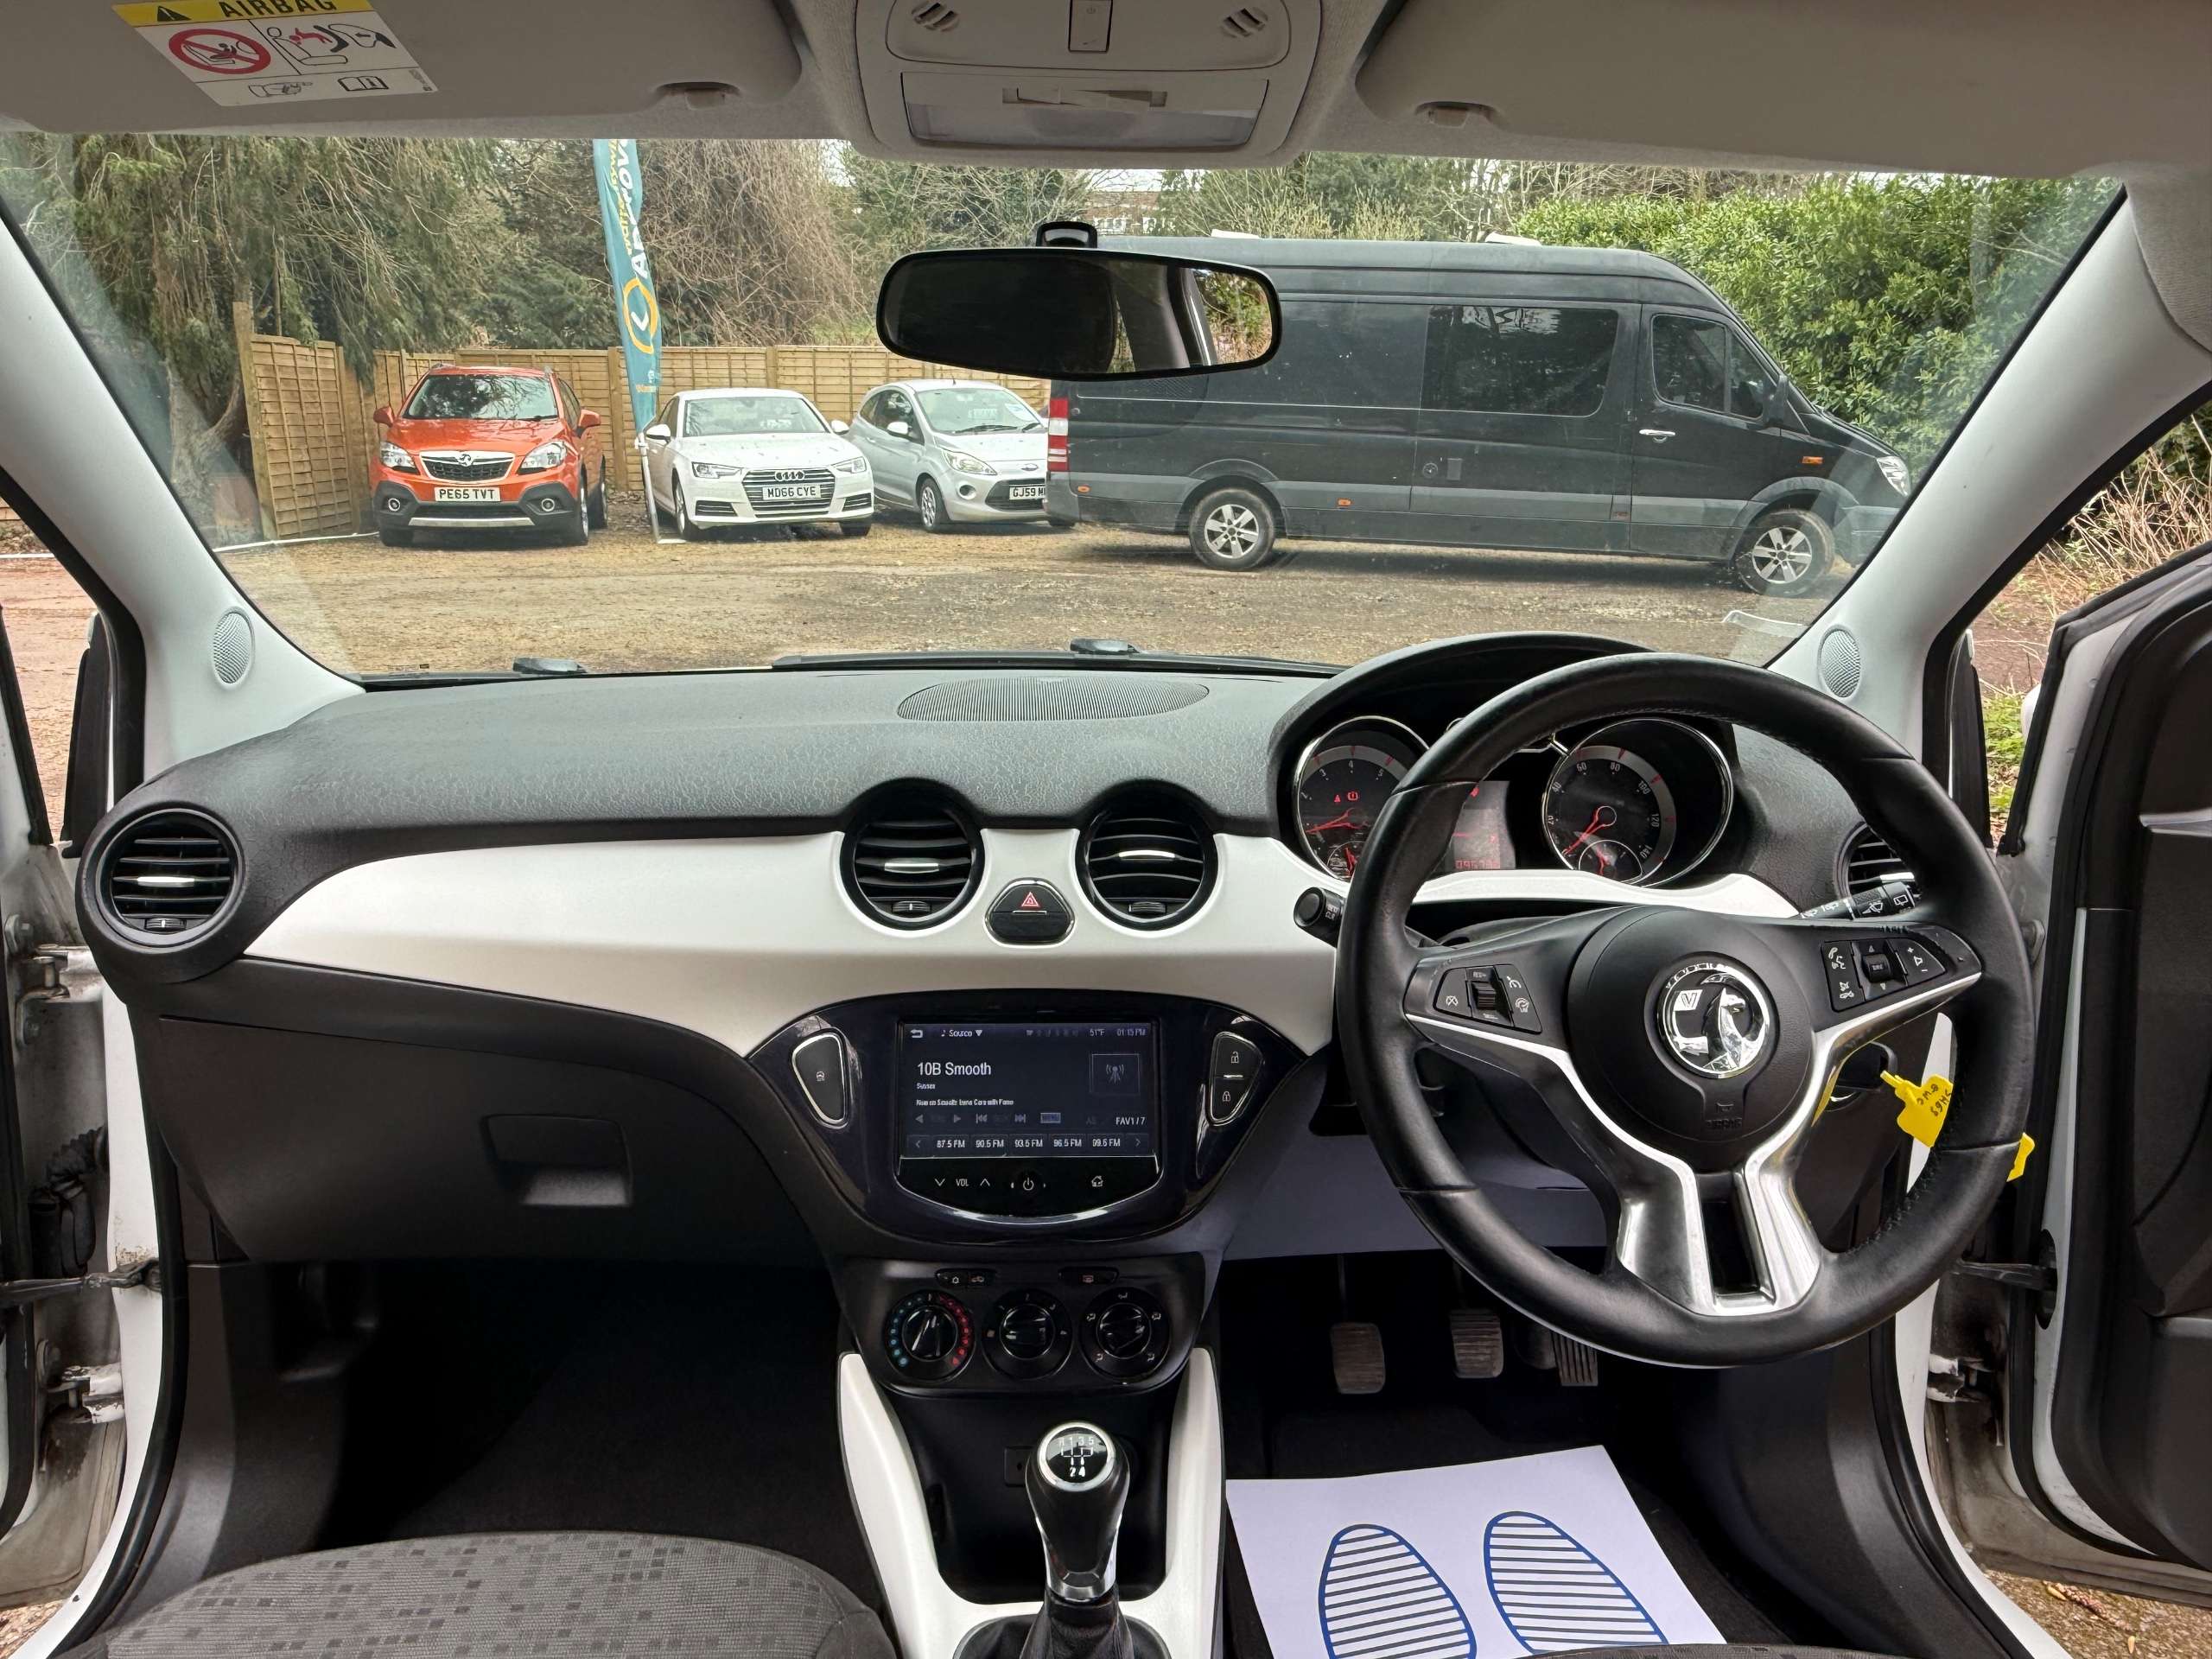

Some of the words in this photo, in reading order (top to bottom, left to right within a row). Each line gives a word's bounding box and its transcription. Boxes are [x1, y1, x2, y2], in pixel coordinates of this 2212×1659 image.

[219, 0, 336, 17] AIRBAG
[439, 488, 469, 499] PE65
[472, 489, 495, 499] TVT
[767, 487, 795, 498] MD66
[797, 486, 817, 496] CYE
[1013, 487, 1035, 498] GJ59
[917, 1062, 942, 1076] 10B
[945, 1062, 992, 1076] Smooth
[954, 1140, 965, 1148] FM
[993, 1140, 1004, 1148] FM
[1032, 1140, 1043, 1148] FM
[1071, 1139, 1082, 1147] FM
[1109, 1138, 1121, 1147] FM
[956, 1178, 969, 1187] VOL
